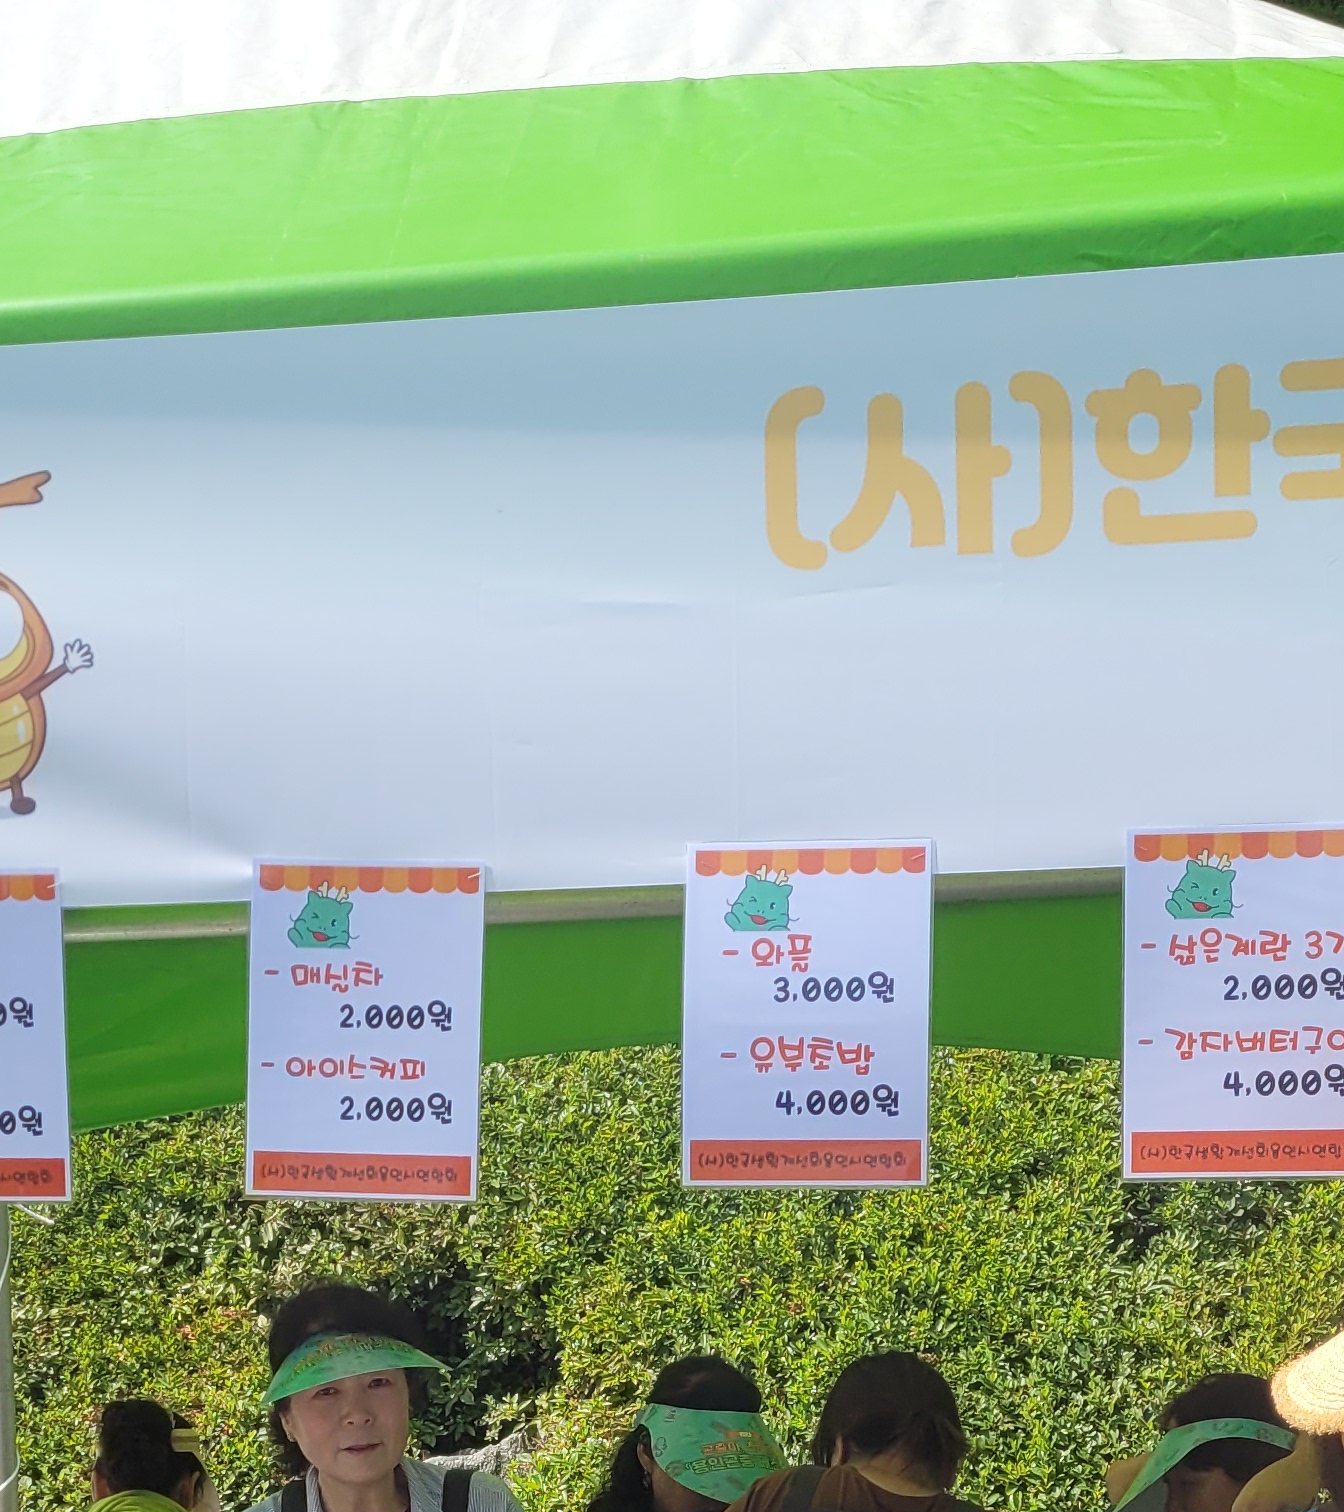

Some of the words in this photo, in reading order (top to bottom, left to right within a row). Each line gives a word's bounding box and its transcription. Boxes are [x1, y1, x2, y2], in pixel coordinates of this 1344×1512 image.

[751, 934, 812, 972] 와플
[1168, 927, 1291, 965] 삶은계란
[290, 961, 384, 993] 매실차
[773, 971, 894, 1003] 3,000원
[339, 999, 452, 1032] 2,000원
[285, 1054, 425, 1080] 아이스커피
[750, 1036, 875, 1075] 유부초밥
[339, 1092, 452, 1125] 2,000원
[775, 1084, 899, 1117] 4,000원
